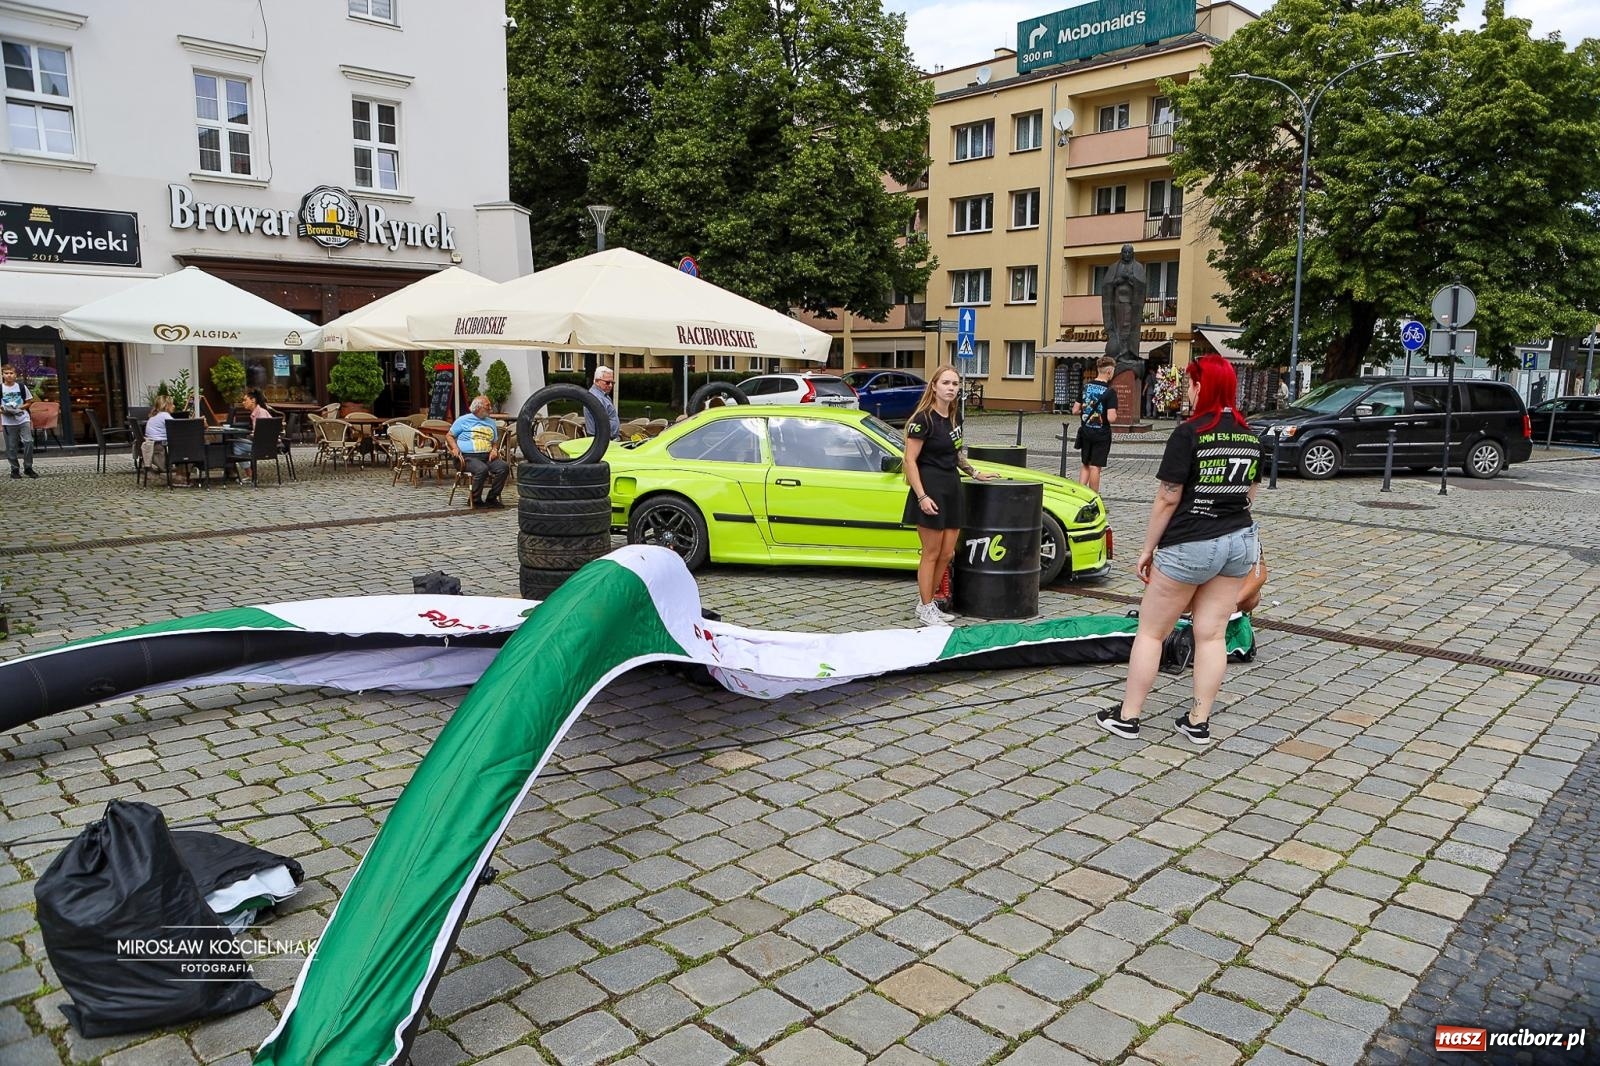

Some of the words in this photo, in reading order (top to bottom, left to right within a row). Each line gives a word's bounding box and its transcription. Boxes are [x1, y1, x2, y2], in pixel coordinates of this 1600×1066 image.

[1057, 10, 1146, 44] McDonald's
[1022, 52, 1041, 64] 300
[1042, 50, 1053, 60] m
[168, 183, 295, 237] Browar
[365, 204, 456, 251] Rynek
[306, 224, 334, 235] Browar
[335, 225, 358, 238] Rynek
[24, 225, 128, 255] Wypieki
[32, 253, 60, 262] 2013
[454, 316, 508, 335] RACIBORSKIE
[193, 330, 239, 340] ALGIDA
[676, 325, 758, 349] RACIBORSKIE
[1527, 353, 1534, 361] P
[1200, 467, 1227, 475] DRIFT
[1228, 457, 1258, 482] 776
[1199, 475, 1224, 483] TEAM
[966, 534, 1007, 565] 776
